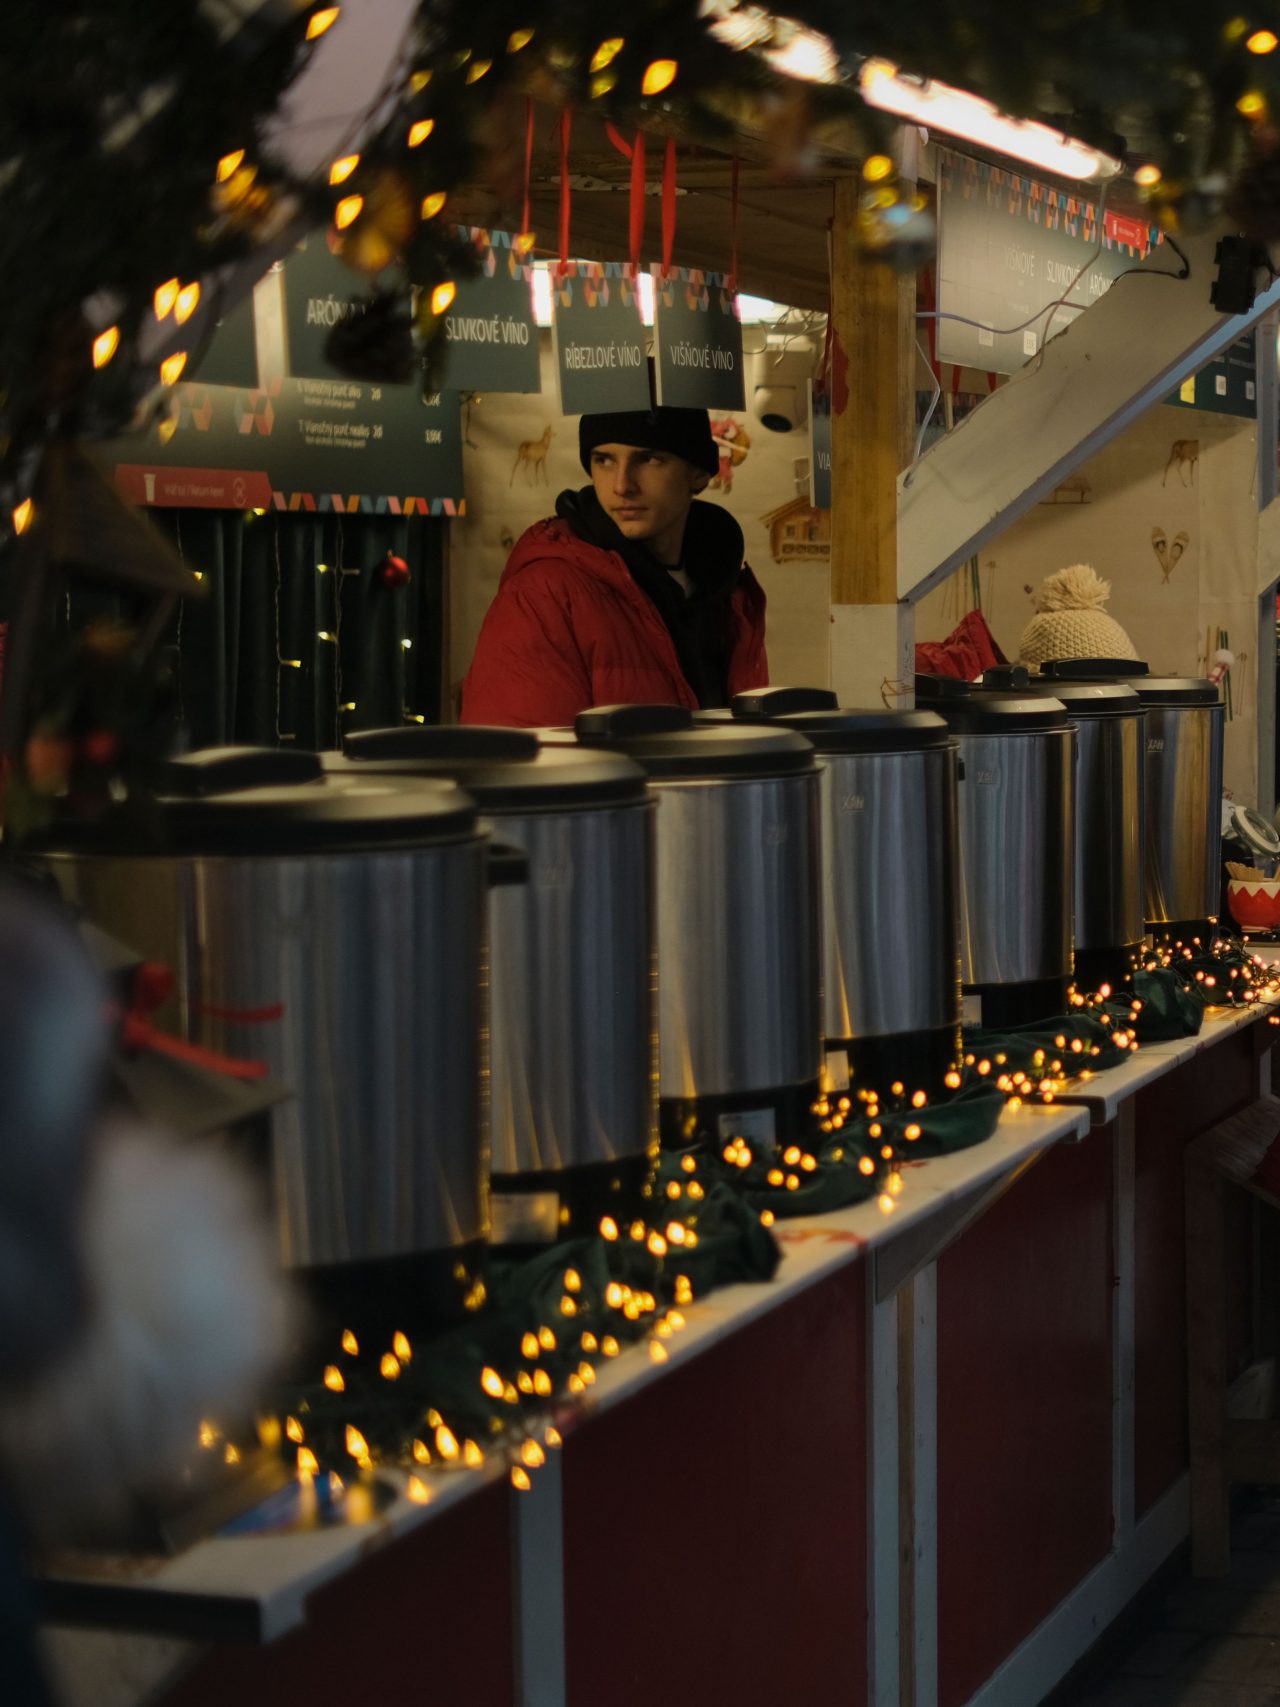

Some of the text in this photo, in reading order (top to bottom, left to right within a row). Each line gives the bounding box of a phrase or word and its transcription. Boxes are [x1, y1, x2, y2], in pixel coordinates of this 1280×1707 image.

[445, 314, 529, 345] SLIVKOVÉ VÍNO
[565, 340, 641, 369] RÍBEZLOVÉ VÍNO
[670, 341, 734, 371] VIŠŇOVÉ VÍNO
